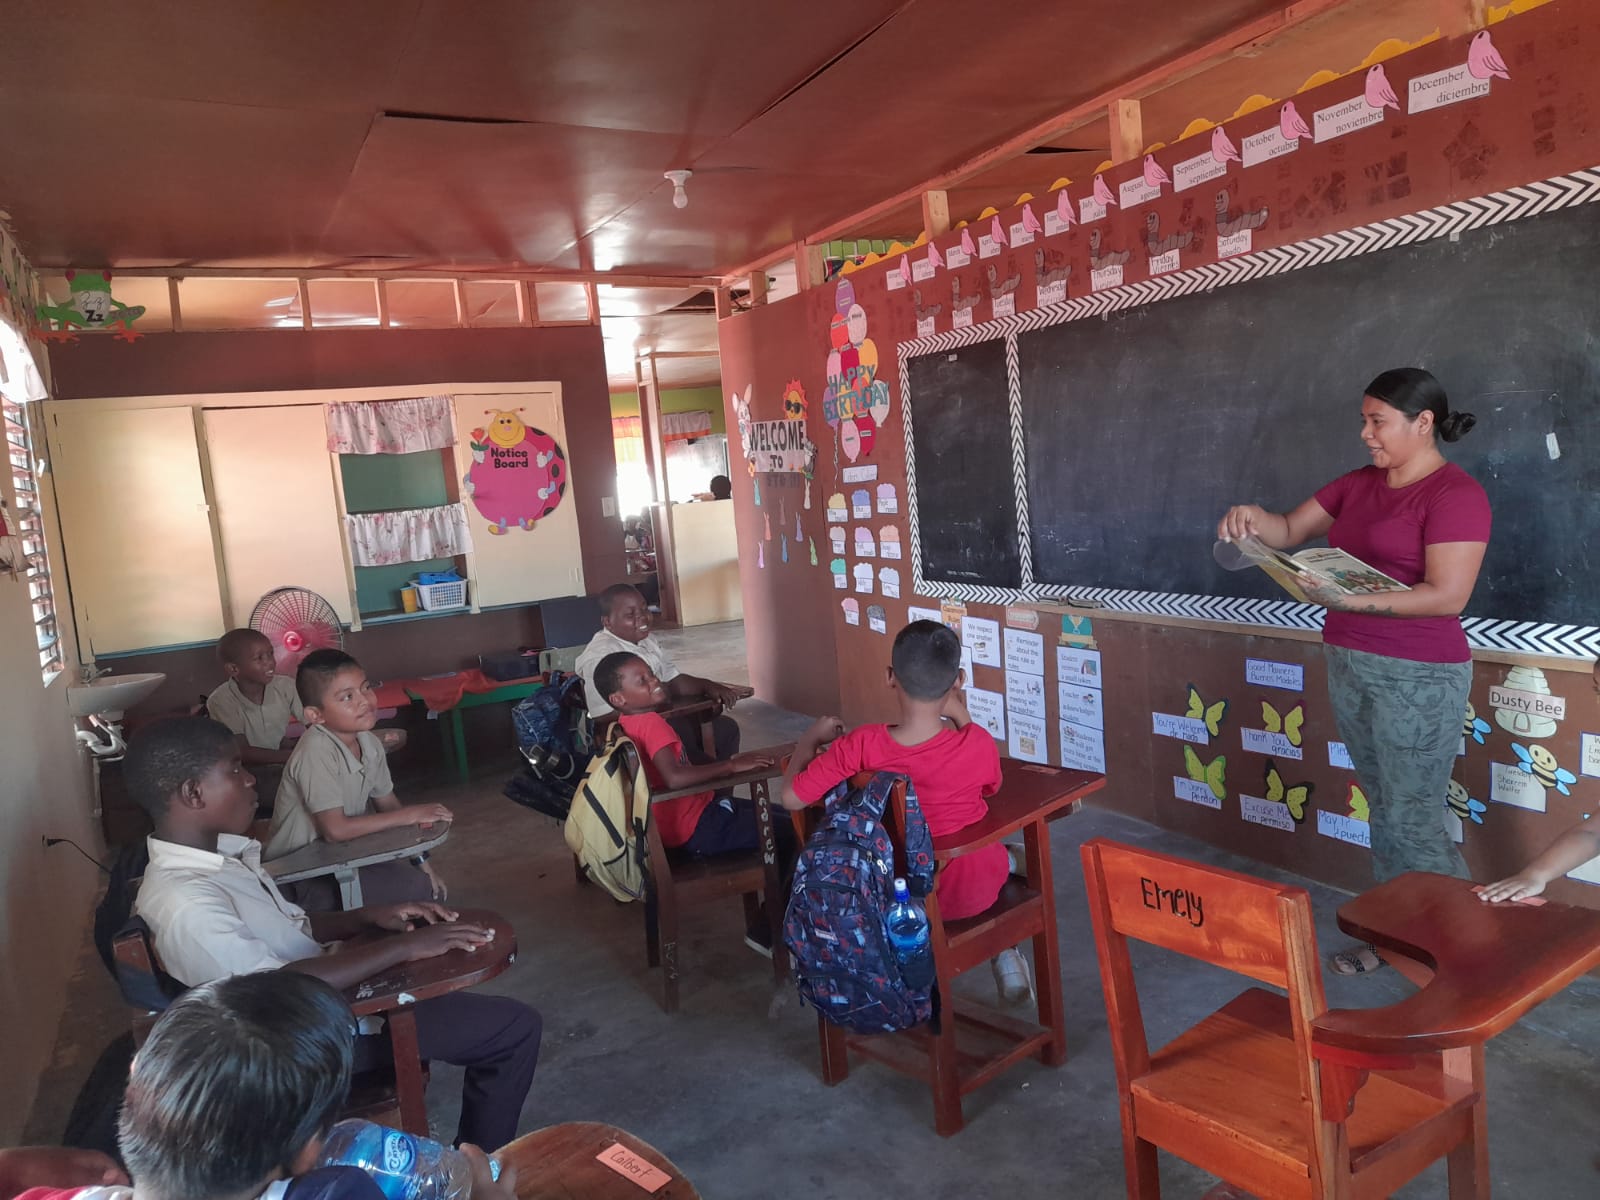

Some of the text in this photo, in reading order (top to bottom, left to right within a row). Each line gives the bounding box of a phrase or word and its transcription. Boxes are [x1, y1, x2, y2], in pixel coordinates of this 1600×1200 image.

[1413, 71, 1464, 93] December
[1437, 82, 1489, 104] diciembre
[1317, 101, 1362, 124] November
[1336, 110, 1383, 133] noviembre
[1245, 133, 1275, 150] October
[1269, 140, 1298, 156] octubre
[1176, 156, 1211, 175] September
[1122, 181, 1144, 194] August
[829, 364, 875, 396] HAPPY
[824, 381, 889, 421] BIRTHDAY
[749, 420, 805, 451] WELCOME
[491, 447, 528, 458] Notice
[770, 454, 784, 469] TO
[494, 457, 529, 469] Board
[1248, 660, 1296, 676] Good Manners
[1491, 691, 1562, 716] Dusty Bee
[1243, 728, 1287, 747] Thank You
[1271, 745, 1301, 758] gracias
[1244, 797, 1274, 816] Excuse
[1260, 815, 1290, 829] permiso
[1319, 811, 1338, 832] May
[1140, 877, 1204, 927] Emely
